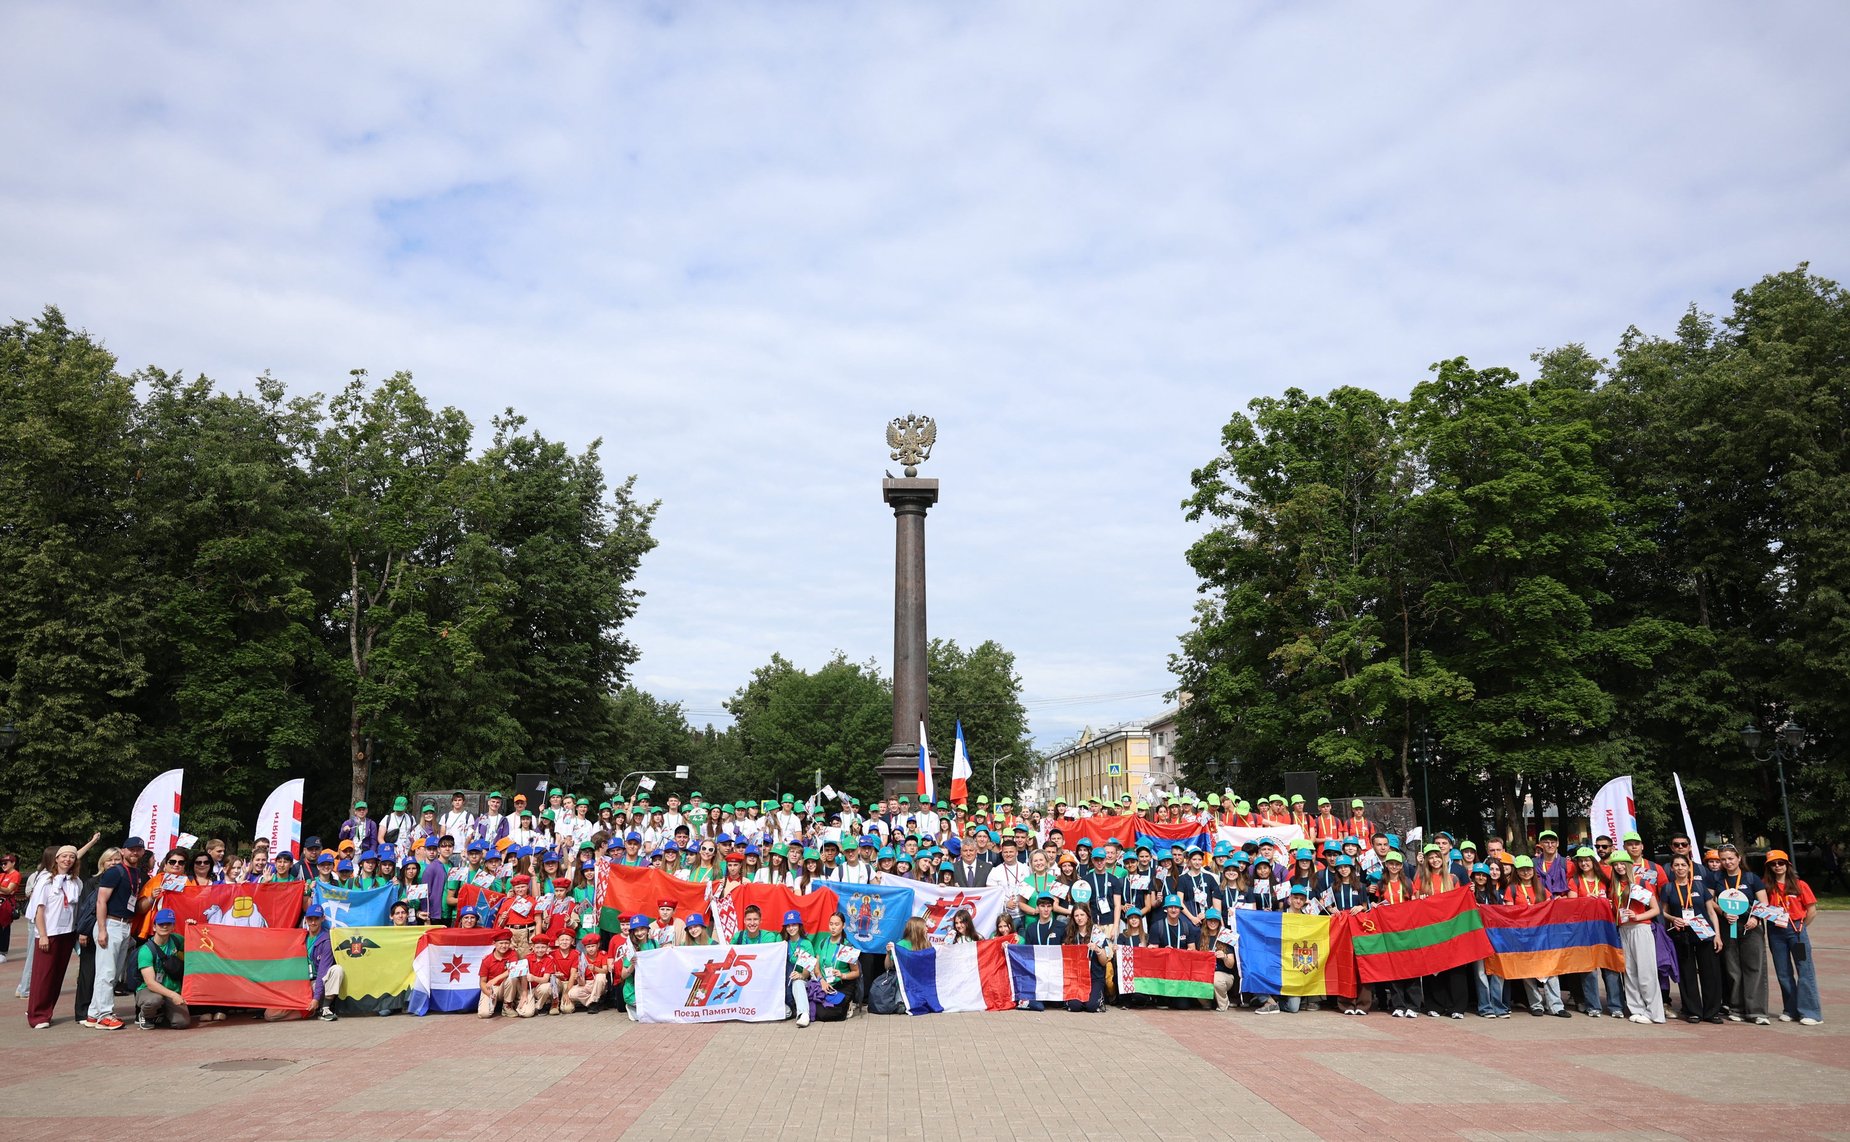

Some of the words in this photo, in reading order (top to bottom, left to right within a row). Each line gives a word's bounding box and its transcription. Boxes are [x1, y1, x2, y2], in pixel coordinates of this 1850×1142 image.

[147, 804, 158, 850] Памяти
[269, 811, 280, 855] Памяти
[1076, 889, 1088, 899] 1.2
[1726, 900, 1740, 910] 1.1
[674, 1009, 700, 1018] Поезд
[702, 1007, 737, 1017] Памяти
[738, 1006, 757, 1016] 2026
